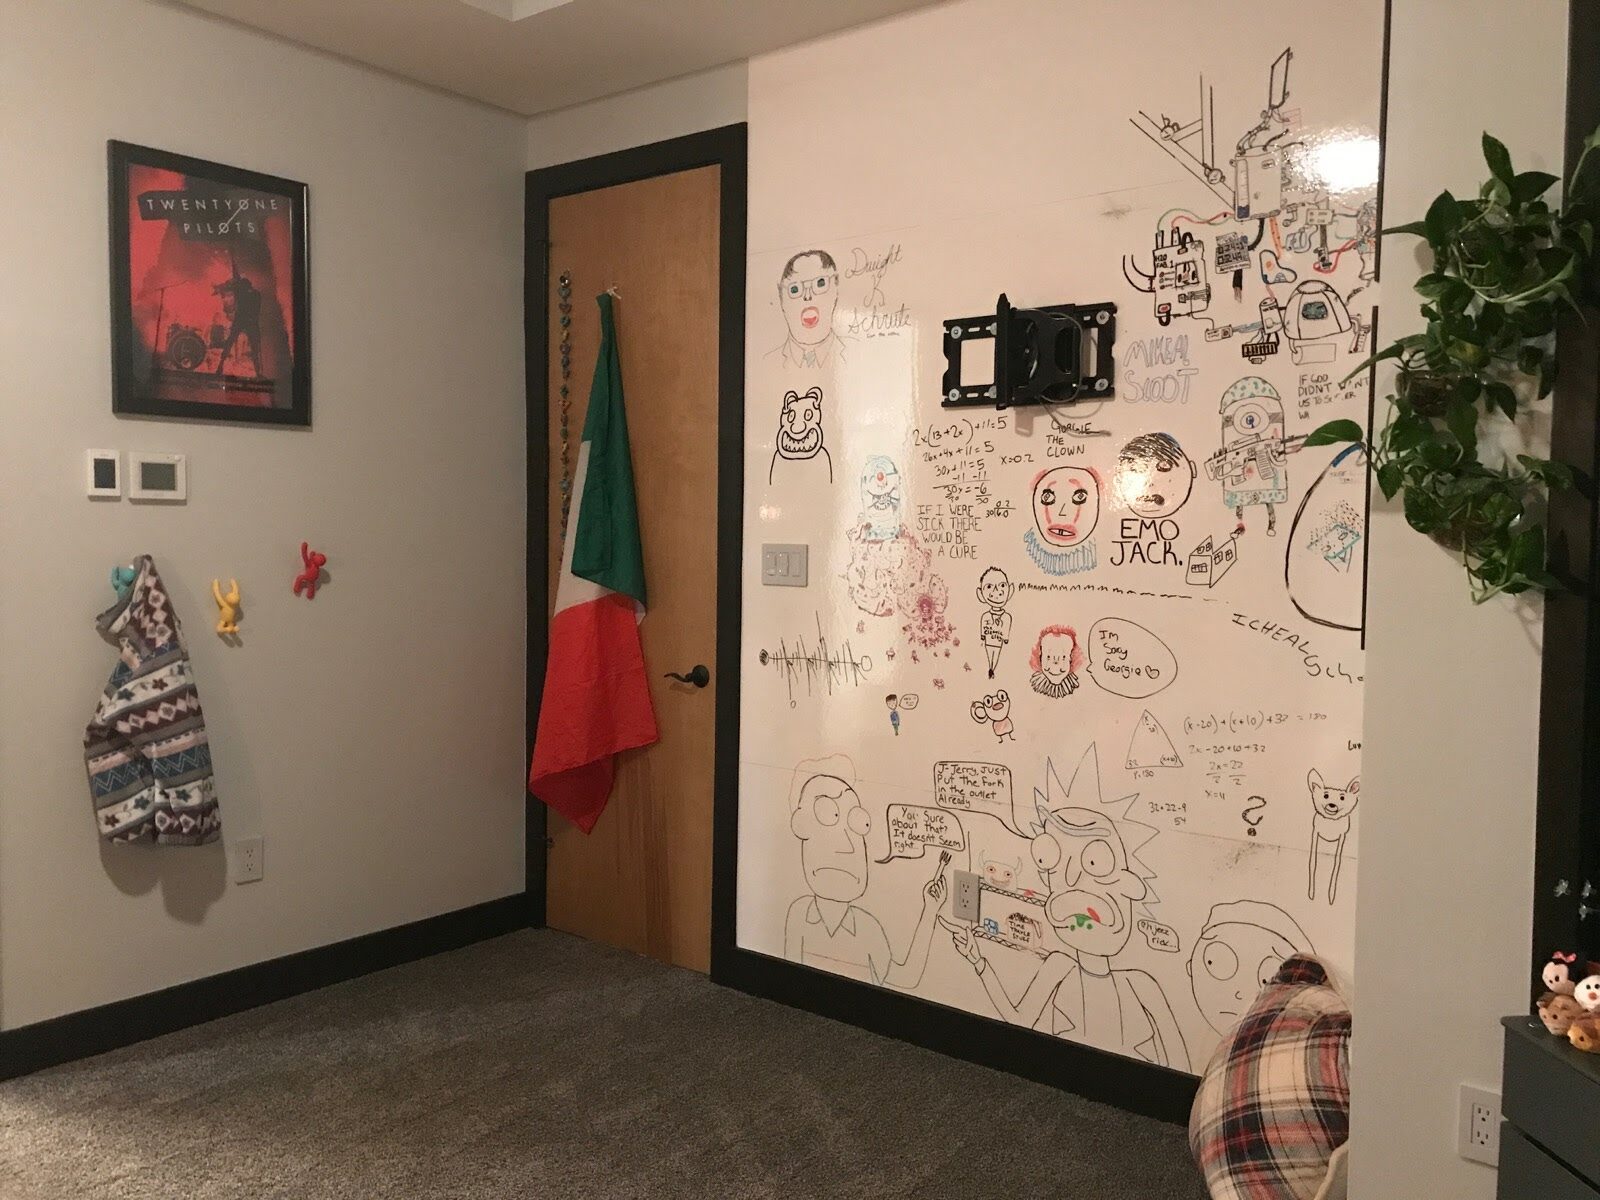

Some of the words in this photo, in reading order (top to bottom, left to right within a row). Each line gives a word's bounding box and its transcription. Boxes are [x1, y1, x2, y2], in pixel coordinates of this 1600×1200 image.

[845, 243, 903, 279] Dwight
[848, 303, 912, 335] Schrute
[1046, 434, 1065, 446] THE
[1046, 443, 1086, 459] CLOWN
[917, 504, 933, 516] IF
[935, 504, 945, 517] I
[948, 503, 975, 518] WERE
[916, 516, 945, 532] SICK
[949, 516, 983, 532] THERE
[1120, 518, 1180, 541] EMO
[921, 531, 953, 544] WOULD
[954, 529, 969, 545] BE
[937, 545, 945, 557] A
[949, 544, 979, 560] CURE
[949, 784, 966, 796] the
[969, 790, 997, 800] outlet
[938, 793, 971, 809] Already
[891, 816, 918, 830] about
[893, 828, 905, 838] It
[894, 841, 914, 853] right
